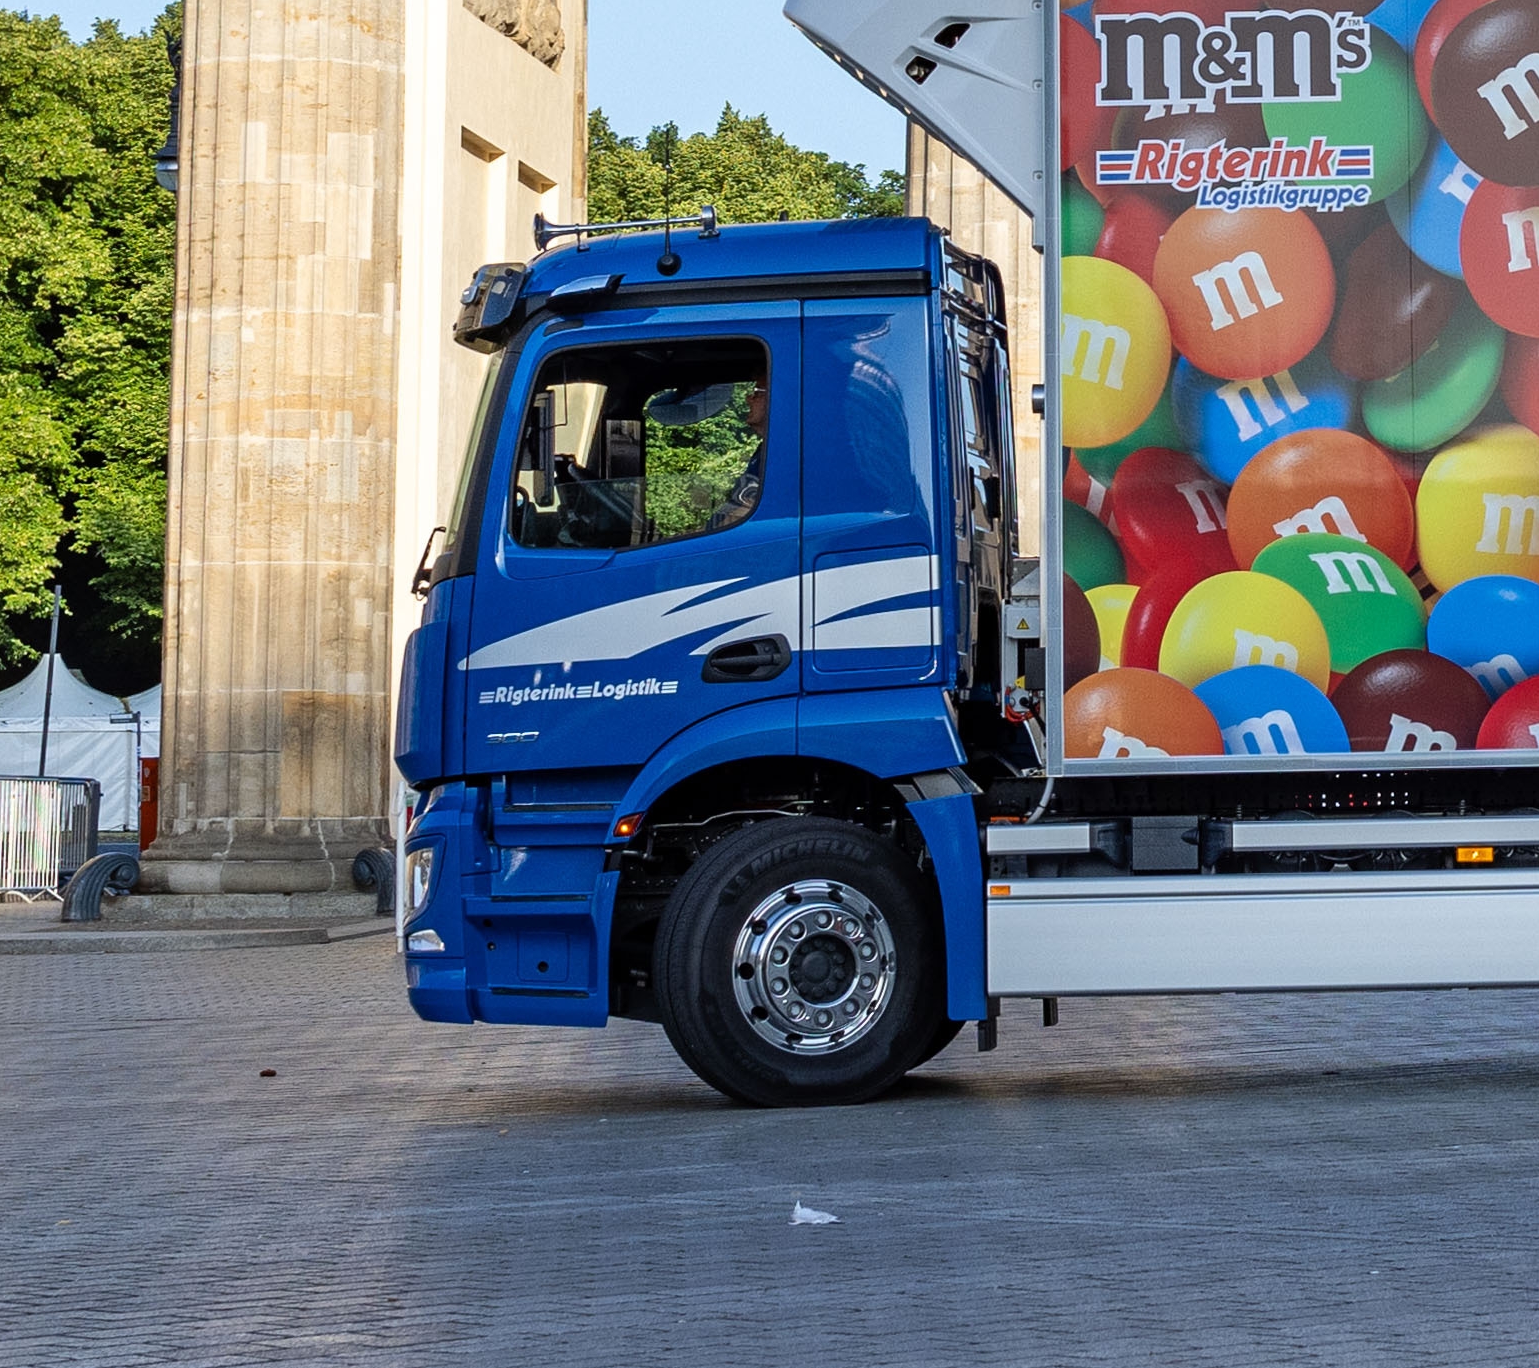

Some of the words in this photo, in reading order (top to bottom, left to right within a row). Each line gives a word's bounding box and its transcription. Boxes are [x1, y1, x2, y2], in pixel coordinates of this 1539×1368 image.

[1134, 138, 1336, 189] Rigterink
[1198, 182, 1369, 211] Logistikgruppe
[494, 682, 577, 706] Rigterink
[592, 677, 663, 701] Logistik
[485, 731, 540, 744] 300
[750, 838, 872, 876] MICHELIN
